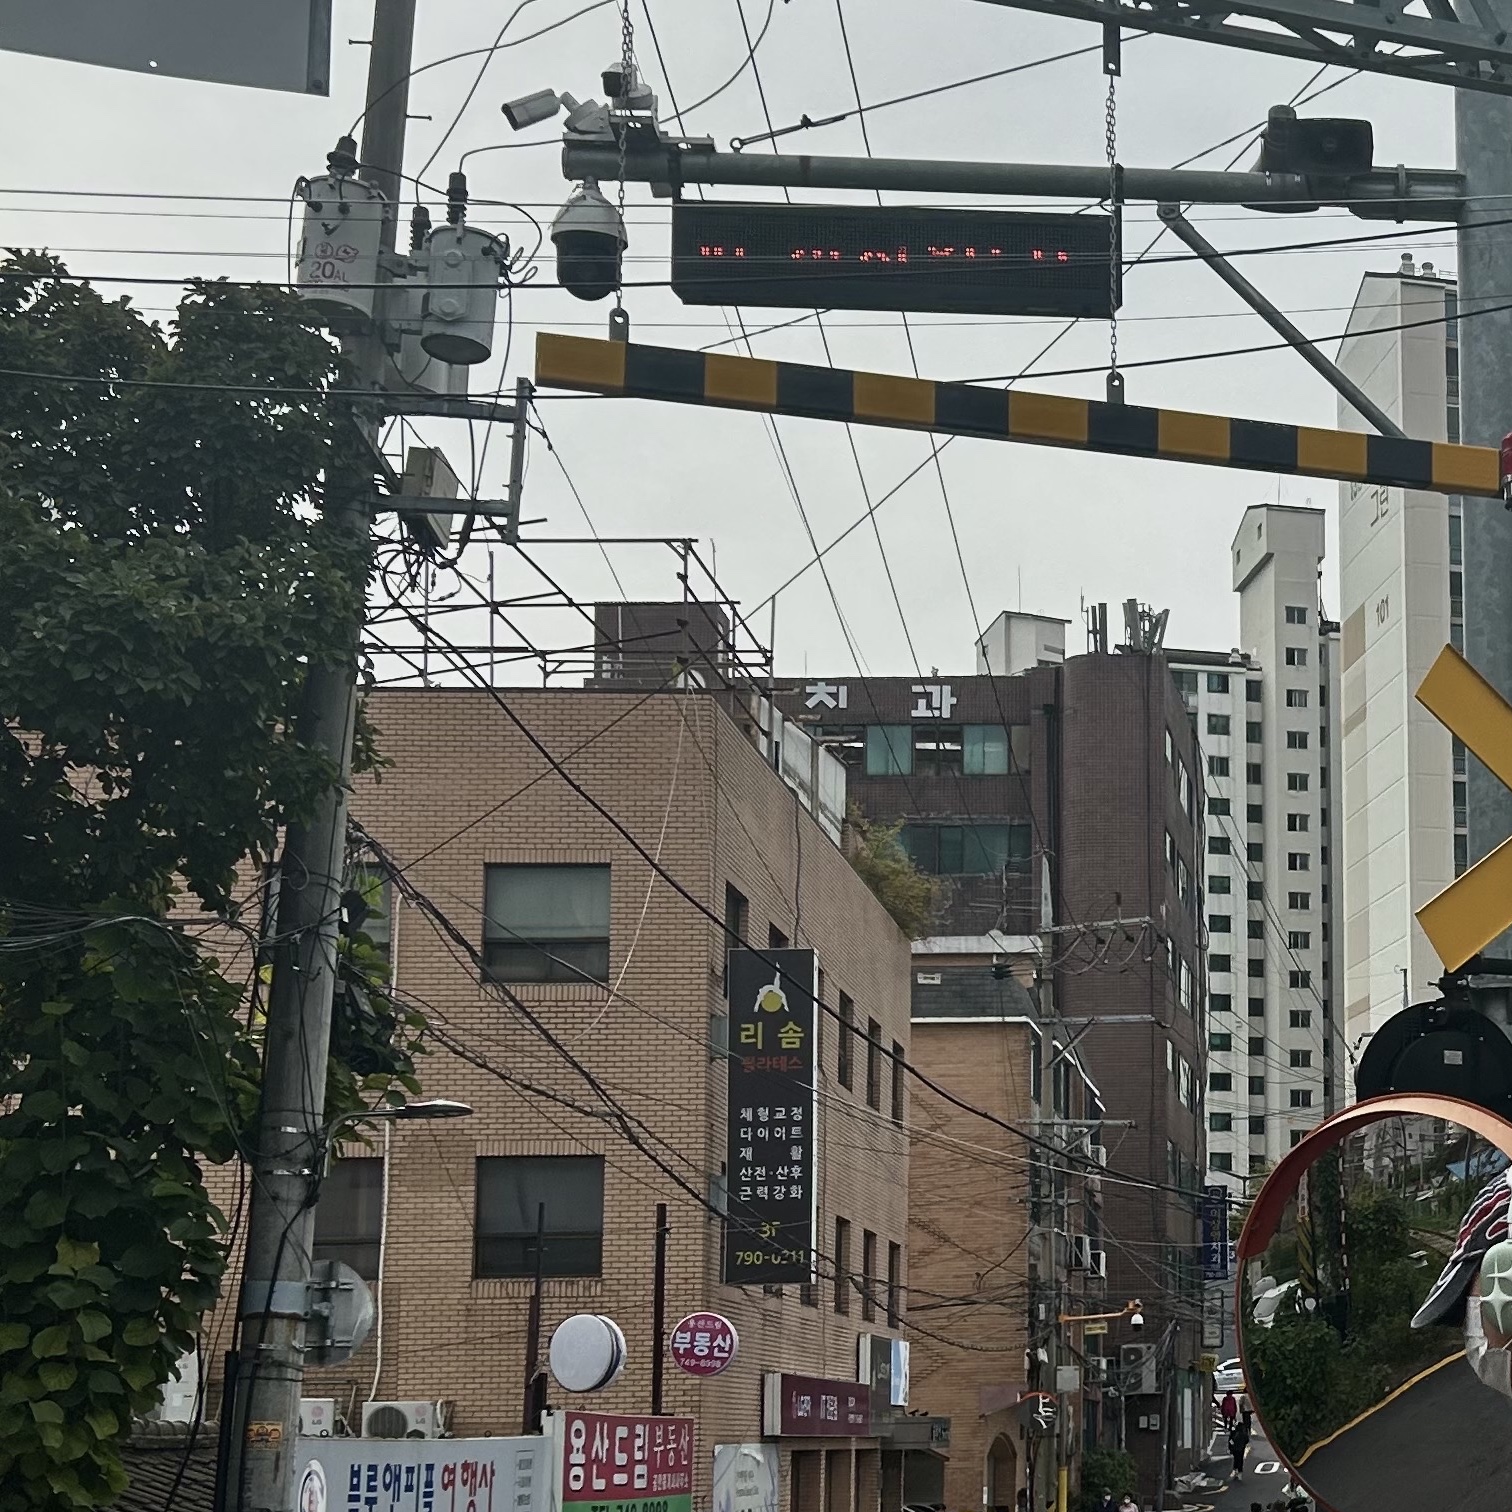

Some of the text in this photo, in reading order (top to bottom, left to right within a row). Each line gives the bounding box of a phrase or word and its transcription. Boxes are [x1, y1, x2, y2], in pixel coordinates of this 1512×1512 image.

[1375, 593, 1389, 628] 101
[804, 681, 958, 719] 치과
[740, 1021, 805, 1050] 리솜
[739, 1106, 803, 1122] 체형교정
[739, 1126, 804, 1142] 다이어트
[739, 1145, 803, 1162] 재활
[739, 1185, 803, 1201] 근력강화
[673, 1330, 732, 1358] 부동산
[568, 1419, 650, 1491] 용산드림
[653, 1423, 690, 1468] 부동산
